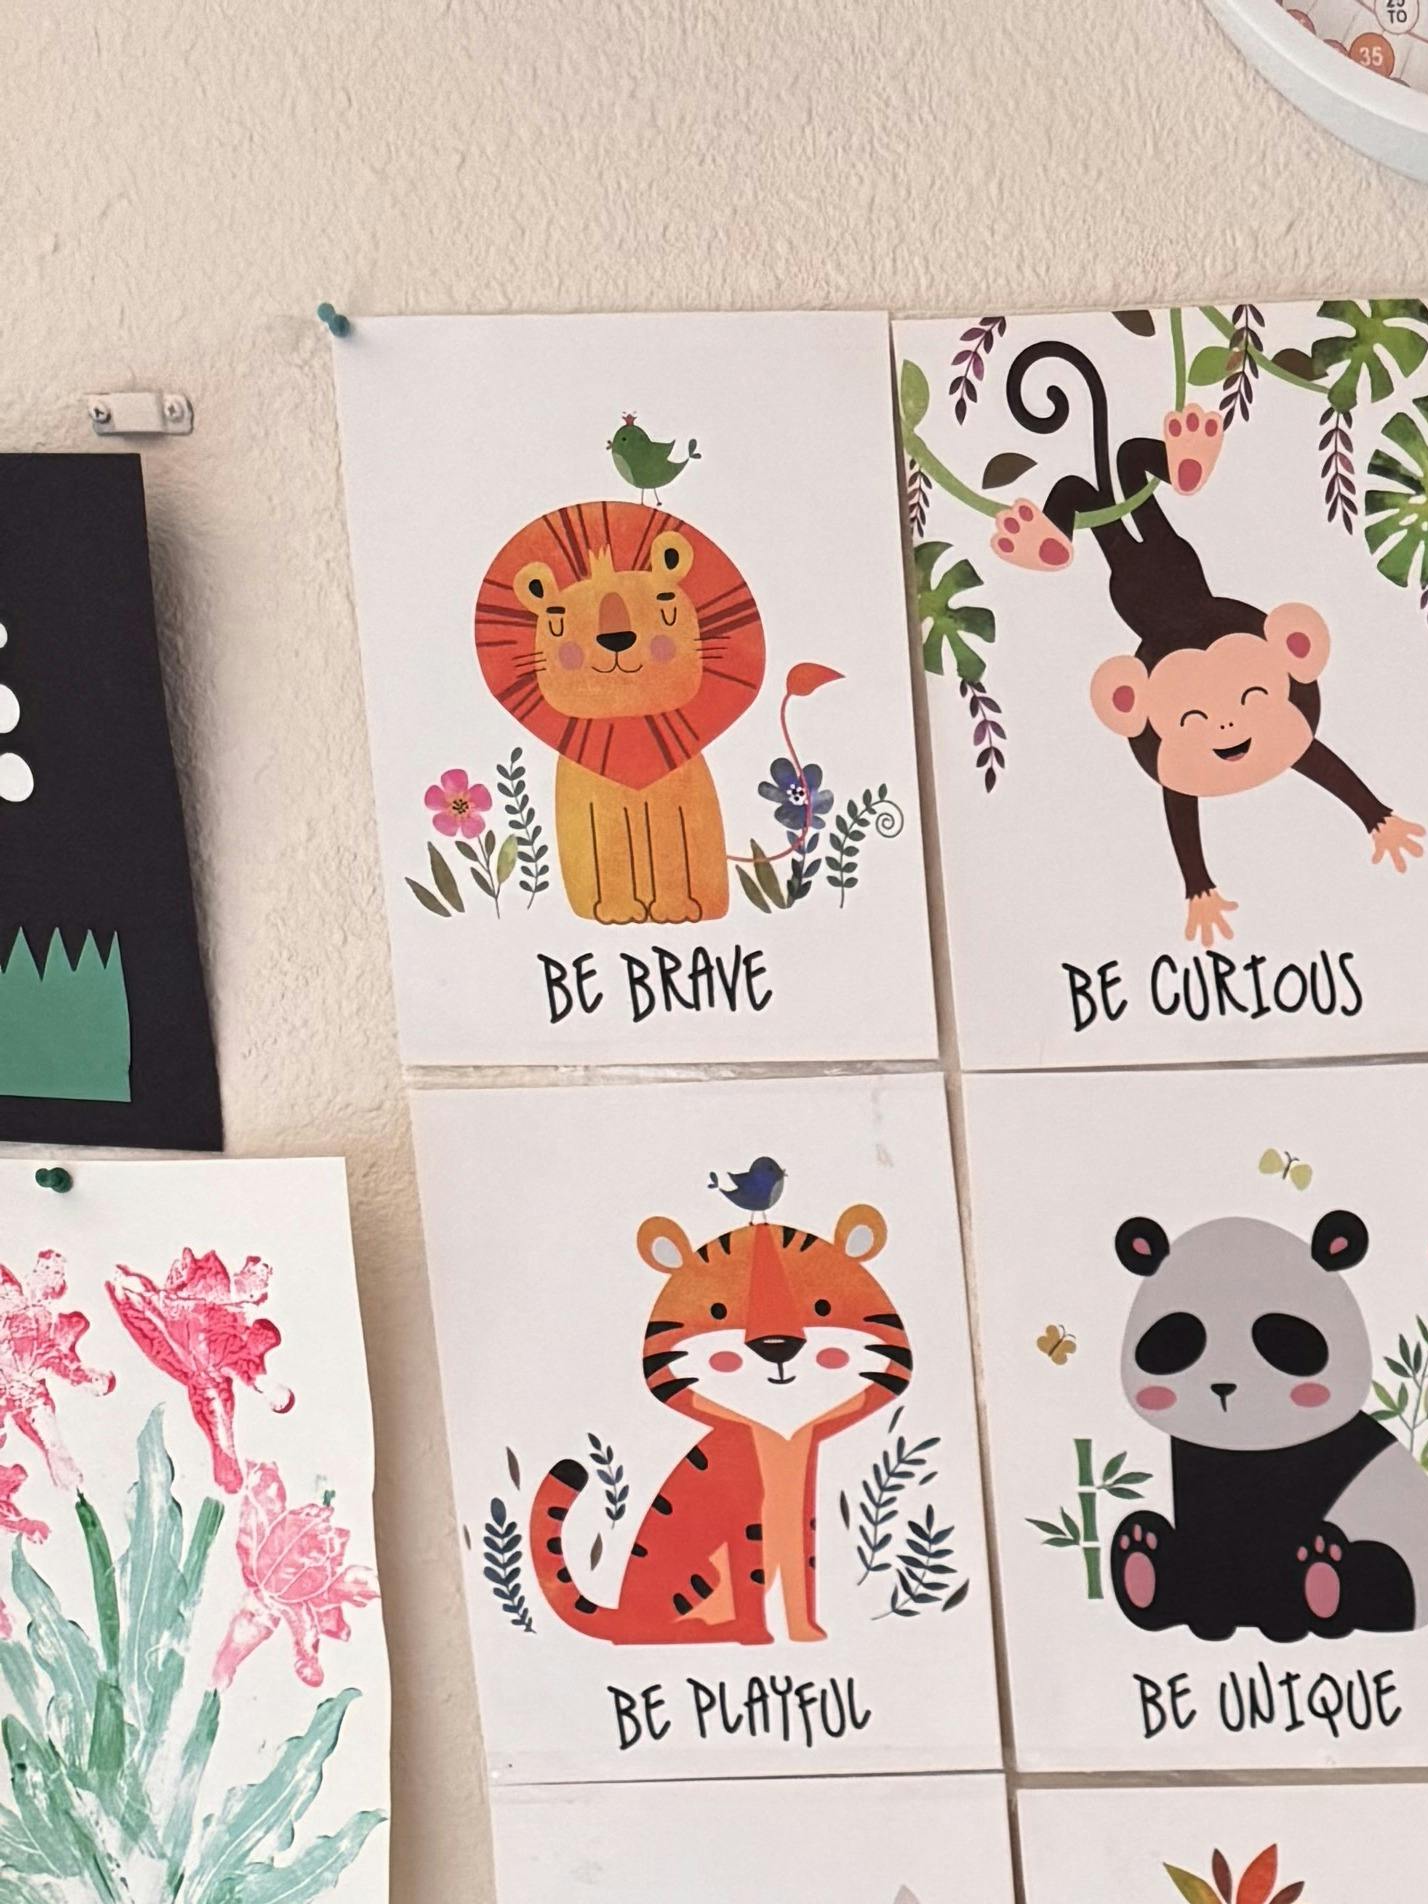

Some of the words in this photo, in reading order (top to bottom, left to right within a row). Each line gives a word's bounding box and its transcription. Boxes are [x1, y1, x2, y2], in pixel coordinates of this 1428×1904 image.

[1387, 10, 1408, 24] TO
[1359, 46, 1384, 66] 35
[538, 953, 603, 1024] BE
[619, 945, 774, 1024] BRAVE
[1060, 960, 1129, 1032] BE
[1148, 950, 1365, 1027] CURIOUS
[607, 1684, 671, 1750] BE
[687, 1676, 872, 1741] PLAYFUL
[1132, 1670, 1197, 1741] BE
[1216, 1669, 1404, 1740] UNIQUE
